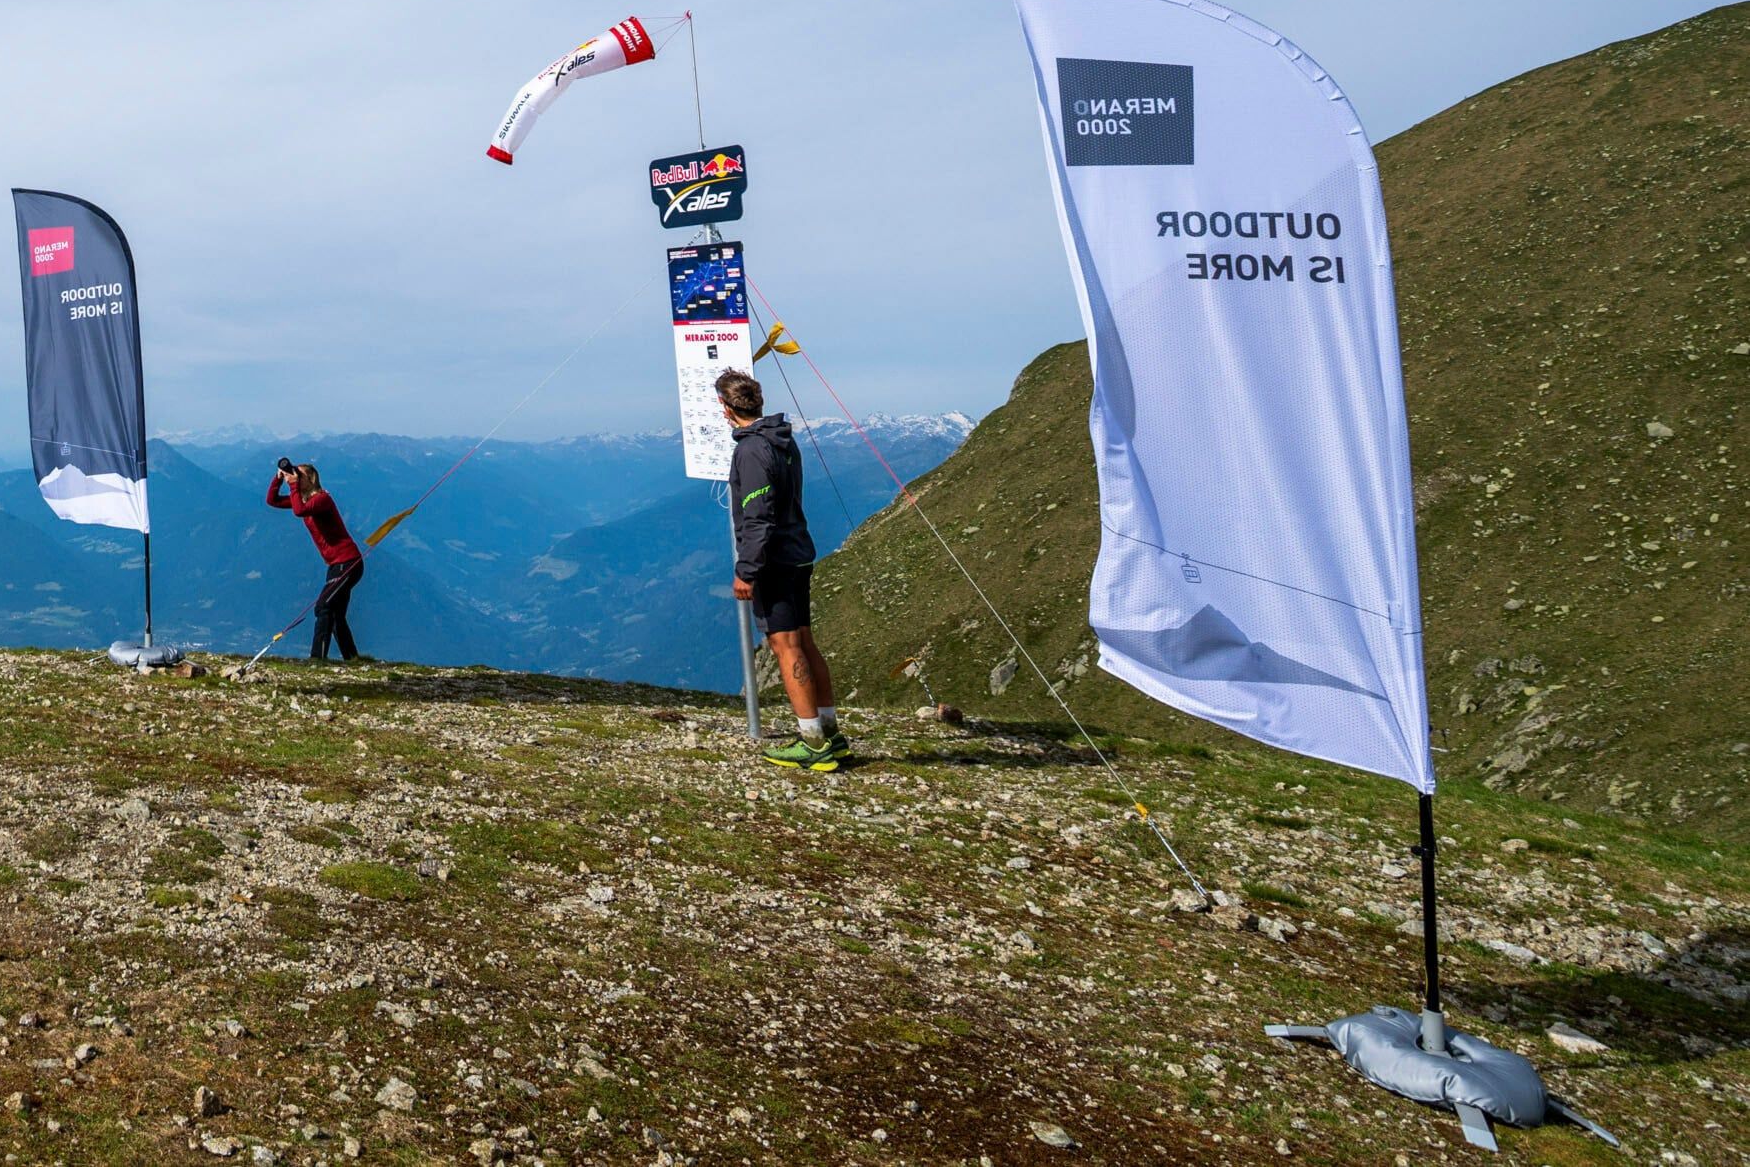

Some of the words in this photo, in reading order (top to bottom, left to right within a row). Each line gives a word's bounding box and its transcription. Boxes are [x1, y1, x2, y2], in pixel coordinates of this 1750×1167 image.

[652, 165, 675, 186] Red
[675, 161, 698, 182] Bull
[684, 334, 716, 342] MERANO
[717, 332, 739, 341] 2000
